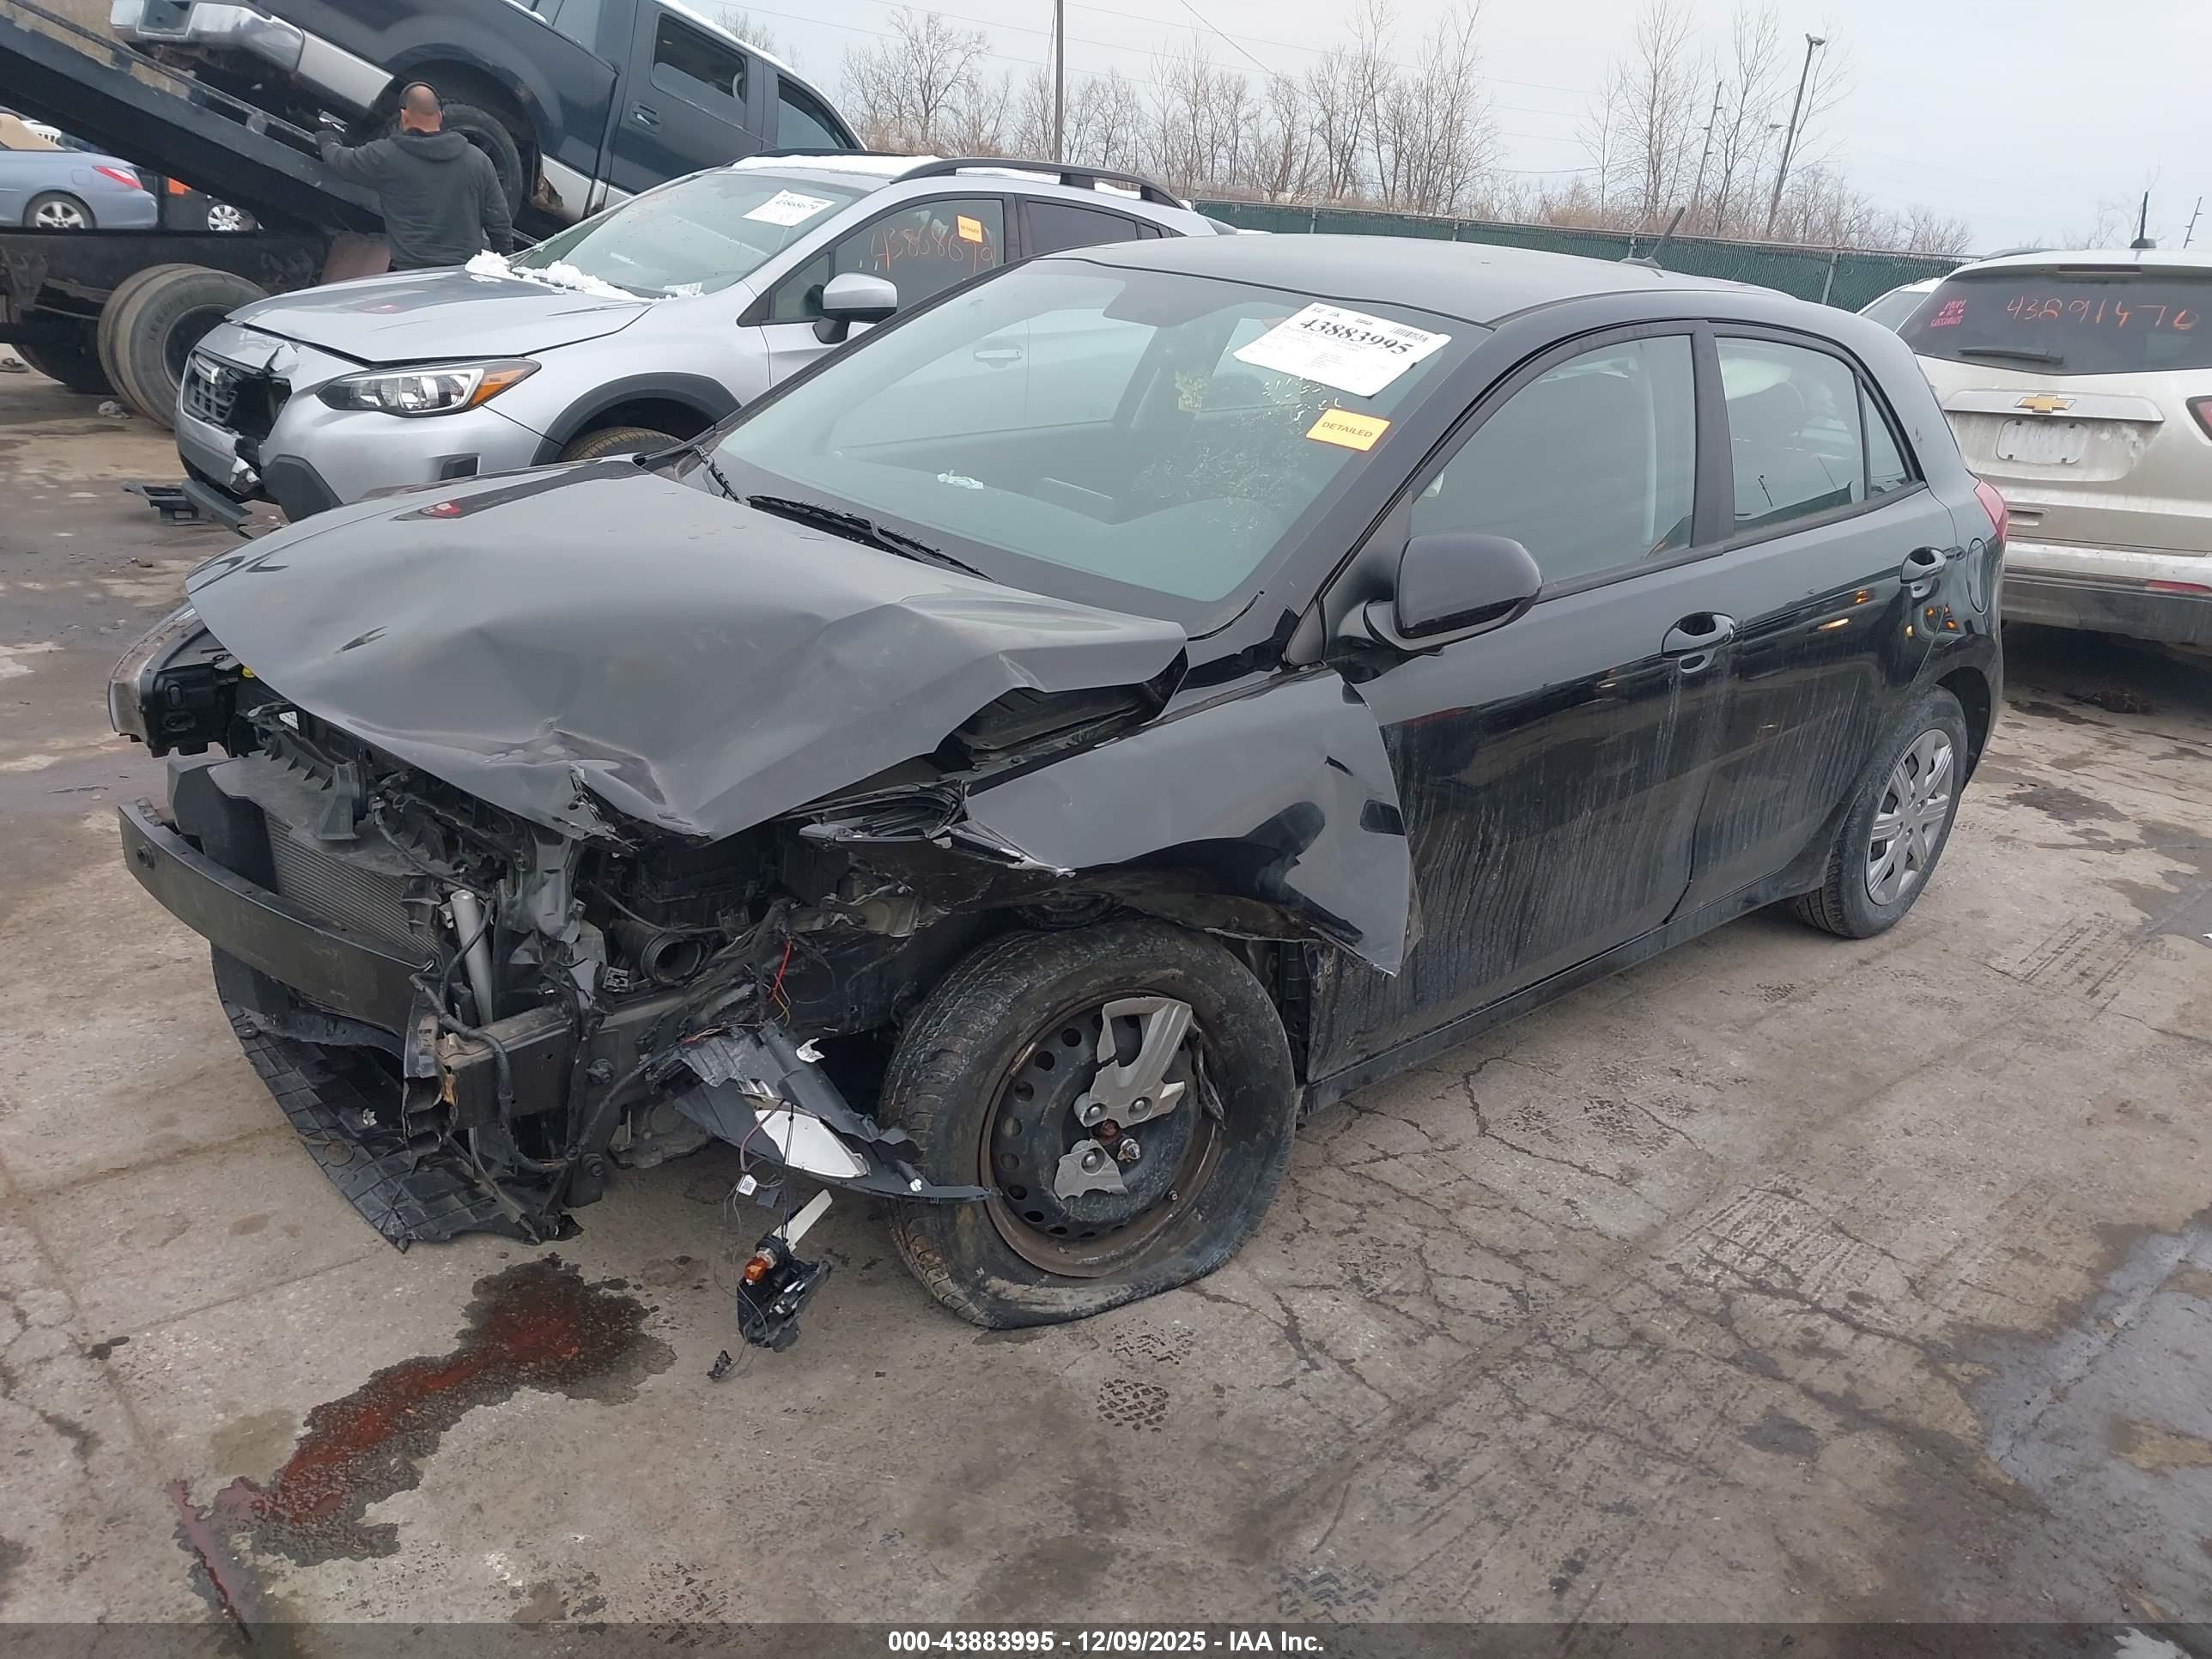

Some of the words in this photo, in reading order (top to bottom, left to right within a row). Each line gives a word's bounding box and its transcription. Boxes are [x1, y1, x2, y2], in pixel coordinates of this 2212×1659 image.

[870, 227, 996, 273] 43868679
[2007, 296, 2200, 331] 43891470
[1300, 319, 1414, 355] 43883995
[1321, 421, 1373, 438] DETAILED
